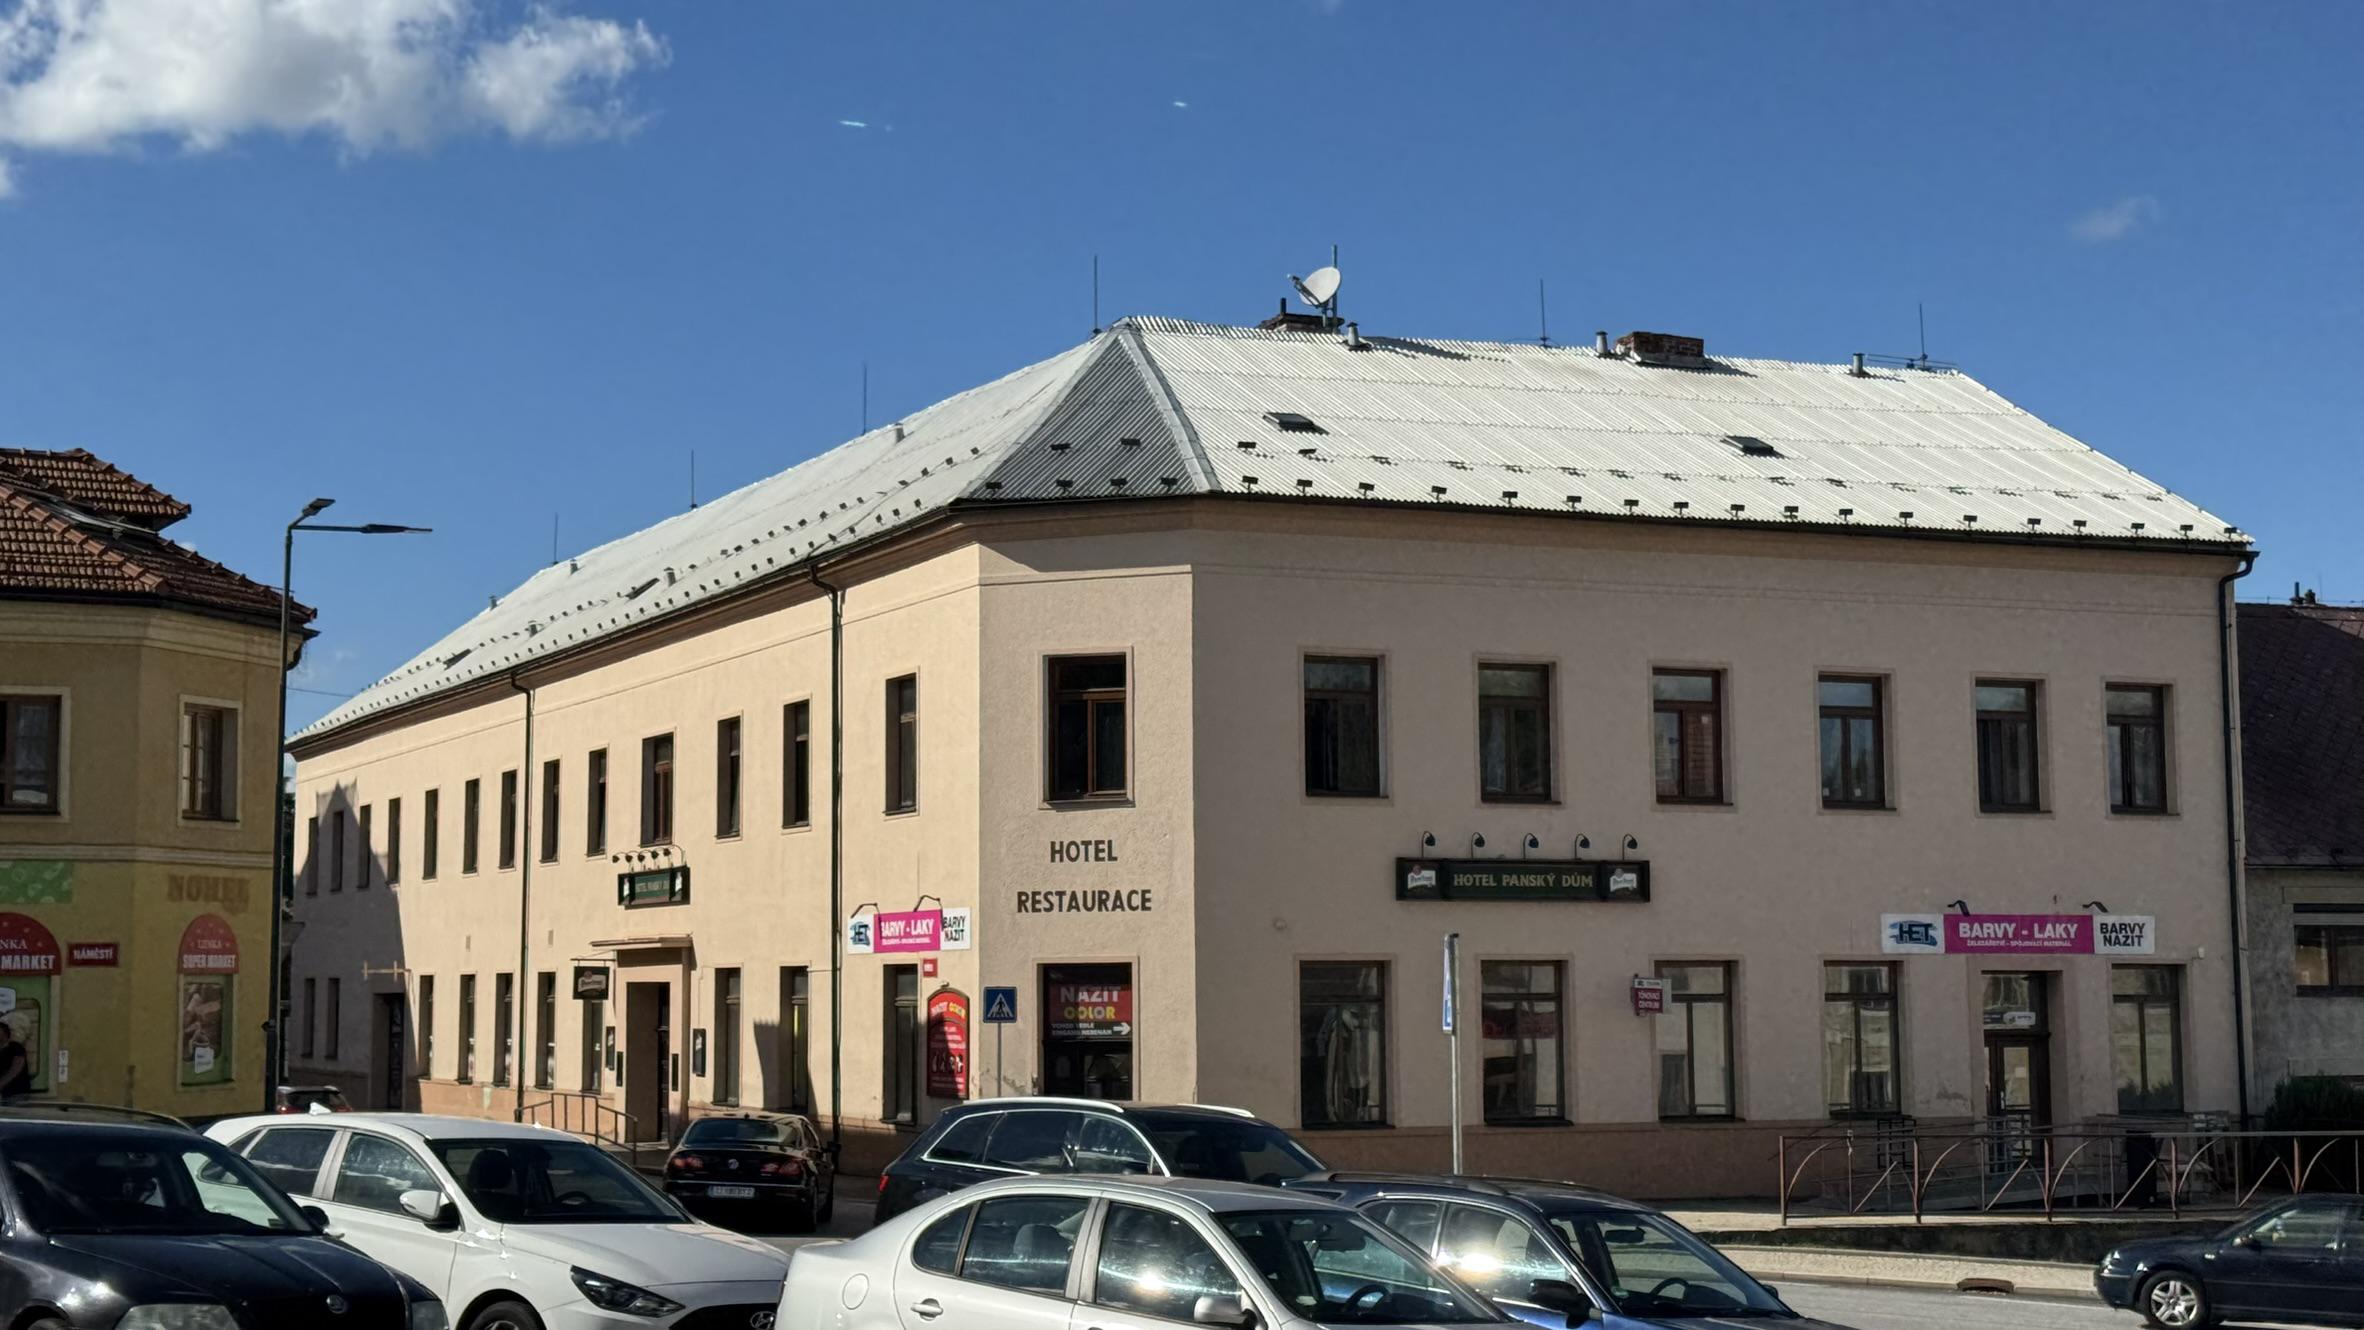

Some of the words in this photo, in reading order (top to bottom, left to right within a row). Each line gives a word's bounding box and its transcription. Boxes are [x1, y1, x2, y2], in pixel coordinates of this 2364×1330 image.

[1050, 839, 1118, 863] HOTEL
[1453, 873, 1497, 887] HOTEL
[1502, 871, 1556, 888] PANSKÝ
[1562, 872, 1593, 887] DŮM
[1017, 889, 1152, 913] RESTAURACE
[881, 920, 905, 937] BARVY
[911, 918, 934, 936] LAKY
[943, 915, 966, 929] BARVY
[2100, 922, 2145, 934] BARVY
[944, 929, 965, 942] NAZIT
[1898, 922, 1934, 943] HET
[1959, 922, 2017, 938] BARVY
[2034, 923, 2078, 939] LAKY
[2103, 934, 2144, 947] NAZIT
[73, 947, 113, 960] NÁMĚSTÍ
[1, 954, 56, 970] MARKET
[1060, 986, 1121, 1003] NAZIT
[1063, 1006, 1116, 1020] COLOR
